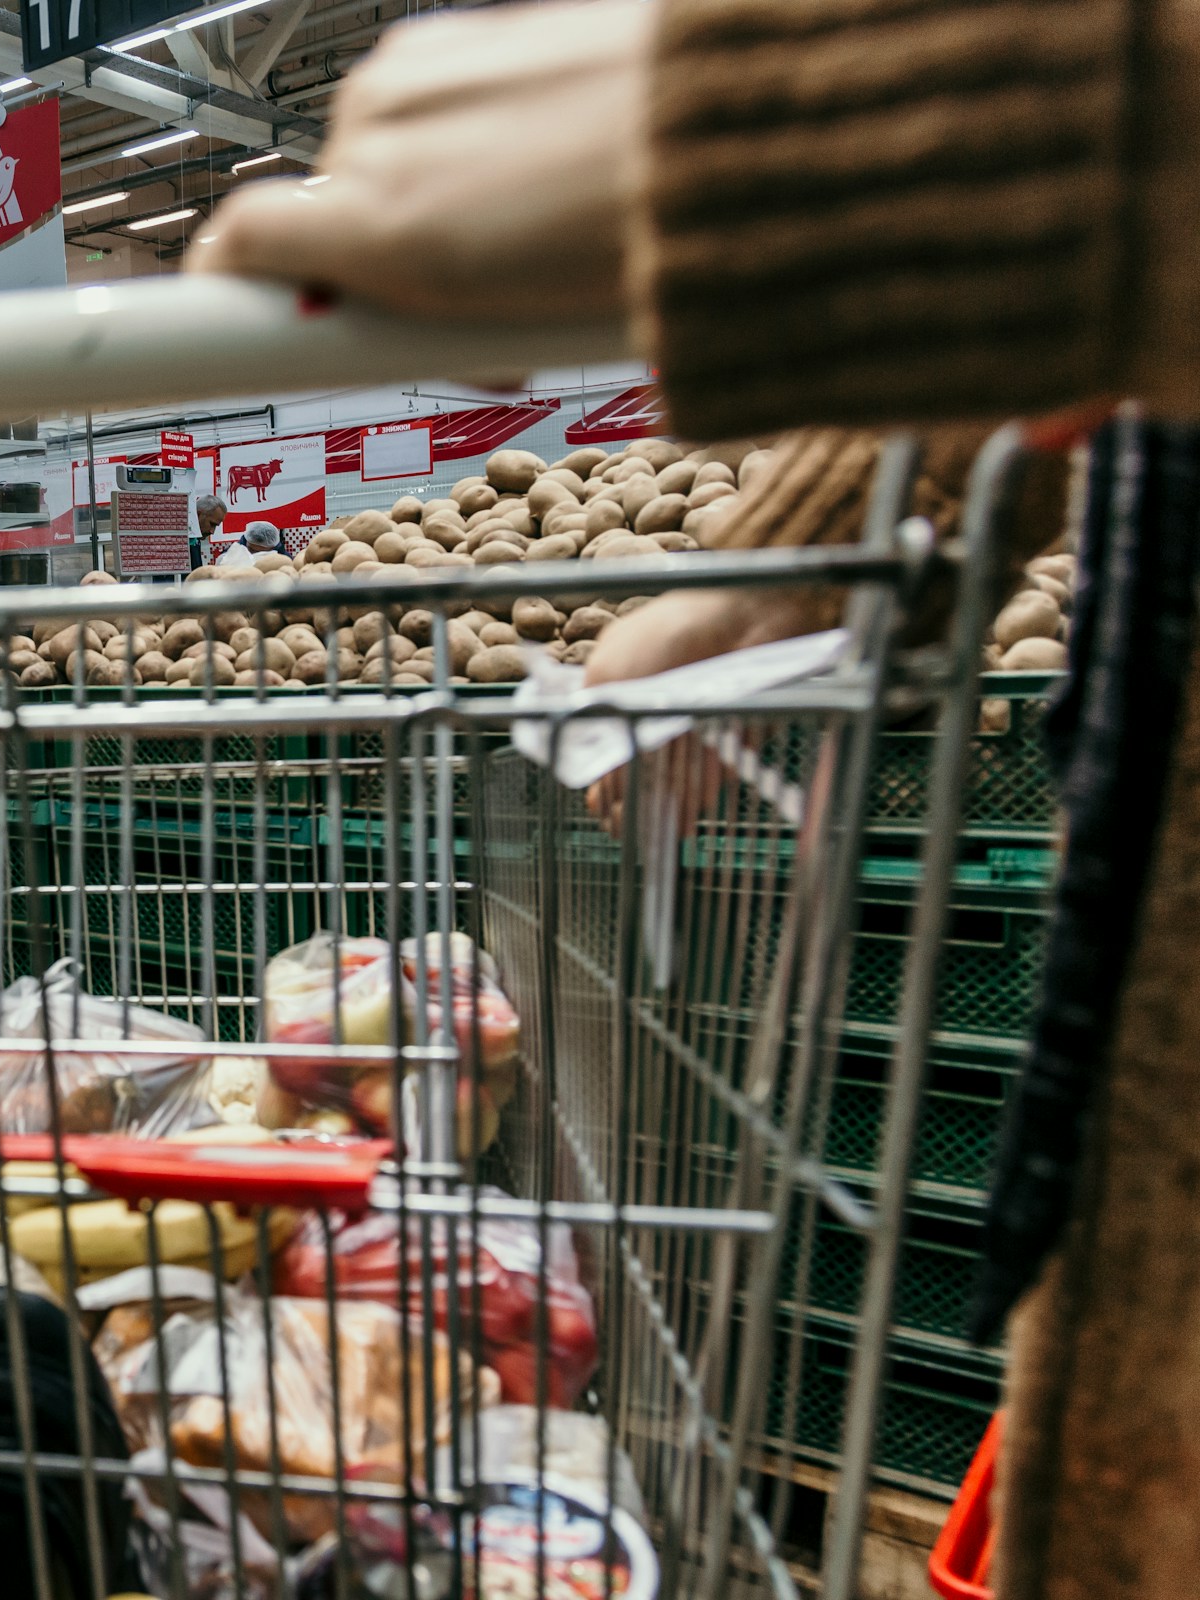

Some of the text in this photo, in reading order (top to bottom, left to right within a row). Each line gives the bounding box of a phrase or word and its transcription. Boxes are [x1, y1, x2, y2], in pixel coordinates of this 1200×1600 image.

[29, 0, 81, 50] 17
[381, 423, 411, 434] ЗНИЖКИ
[280, 441, 320, 452] ЯЛОВИЧИНА
[300, 512, 321, 522] Ашан
